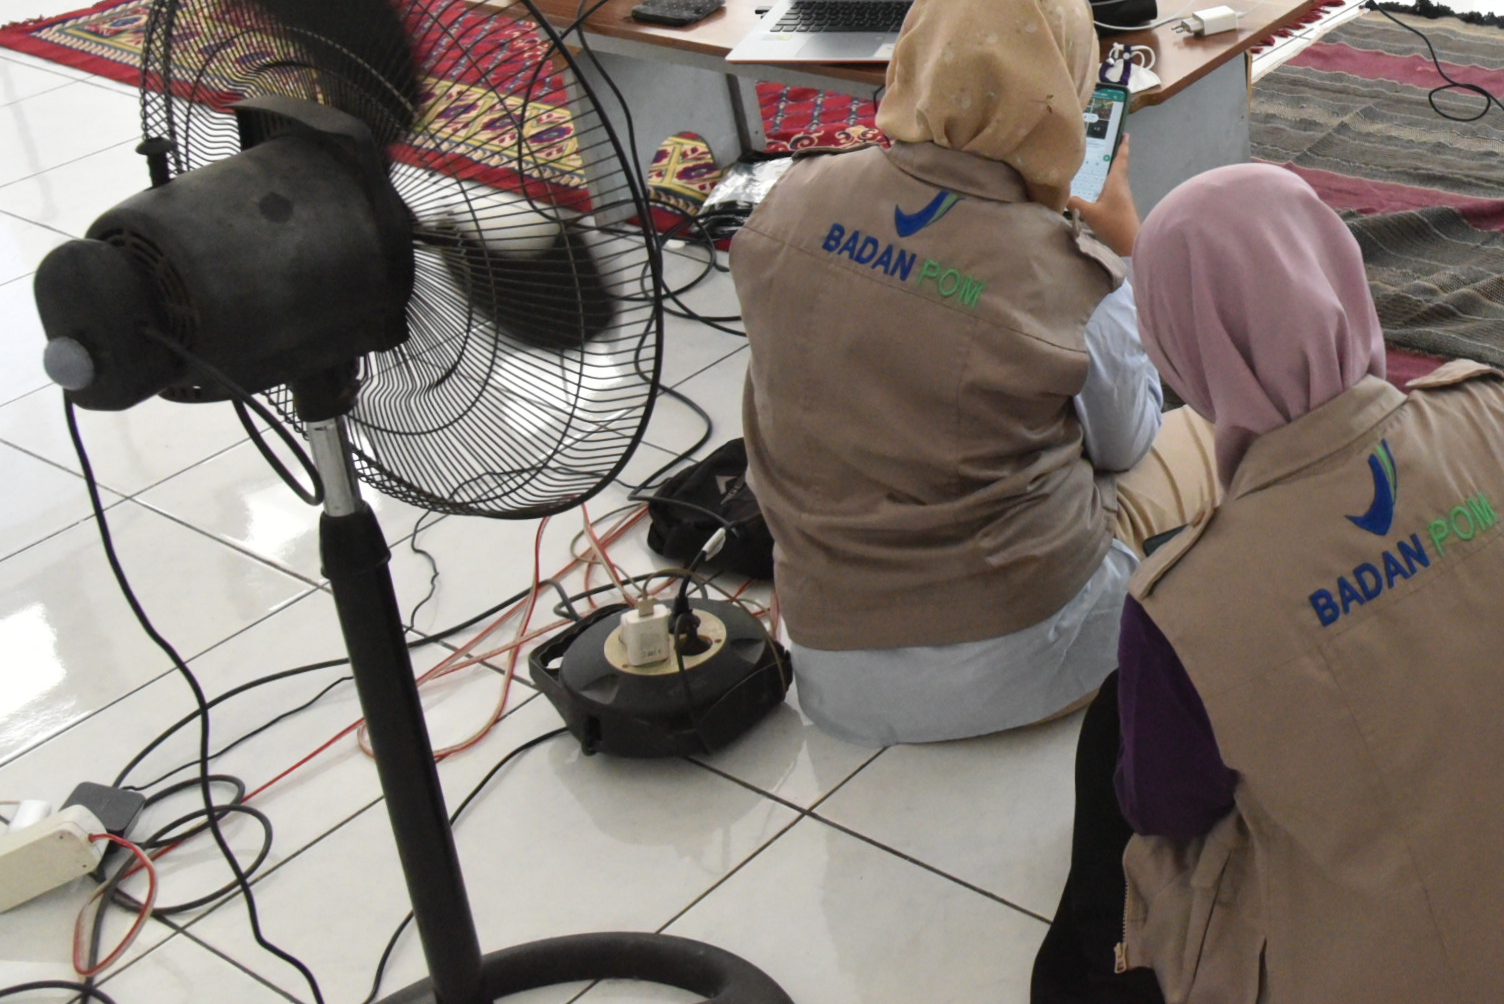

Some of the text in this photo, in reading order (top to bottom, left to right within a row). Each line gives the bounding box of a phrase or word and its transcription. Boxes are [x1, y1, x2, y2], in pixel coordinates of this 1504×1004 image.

[822, 222, 987, 309] BADAN POM
[1308, 490, 1499, 628] BADAN POM
